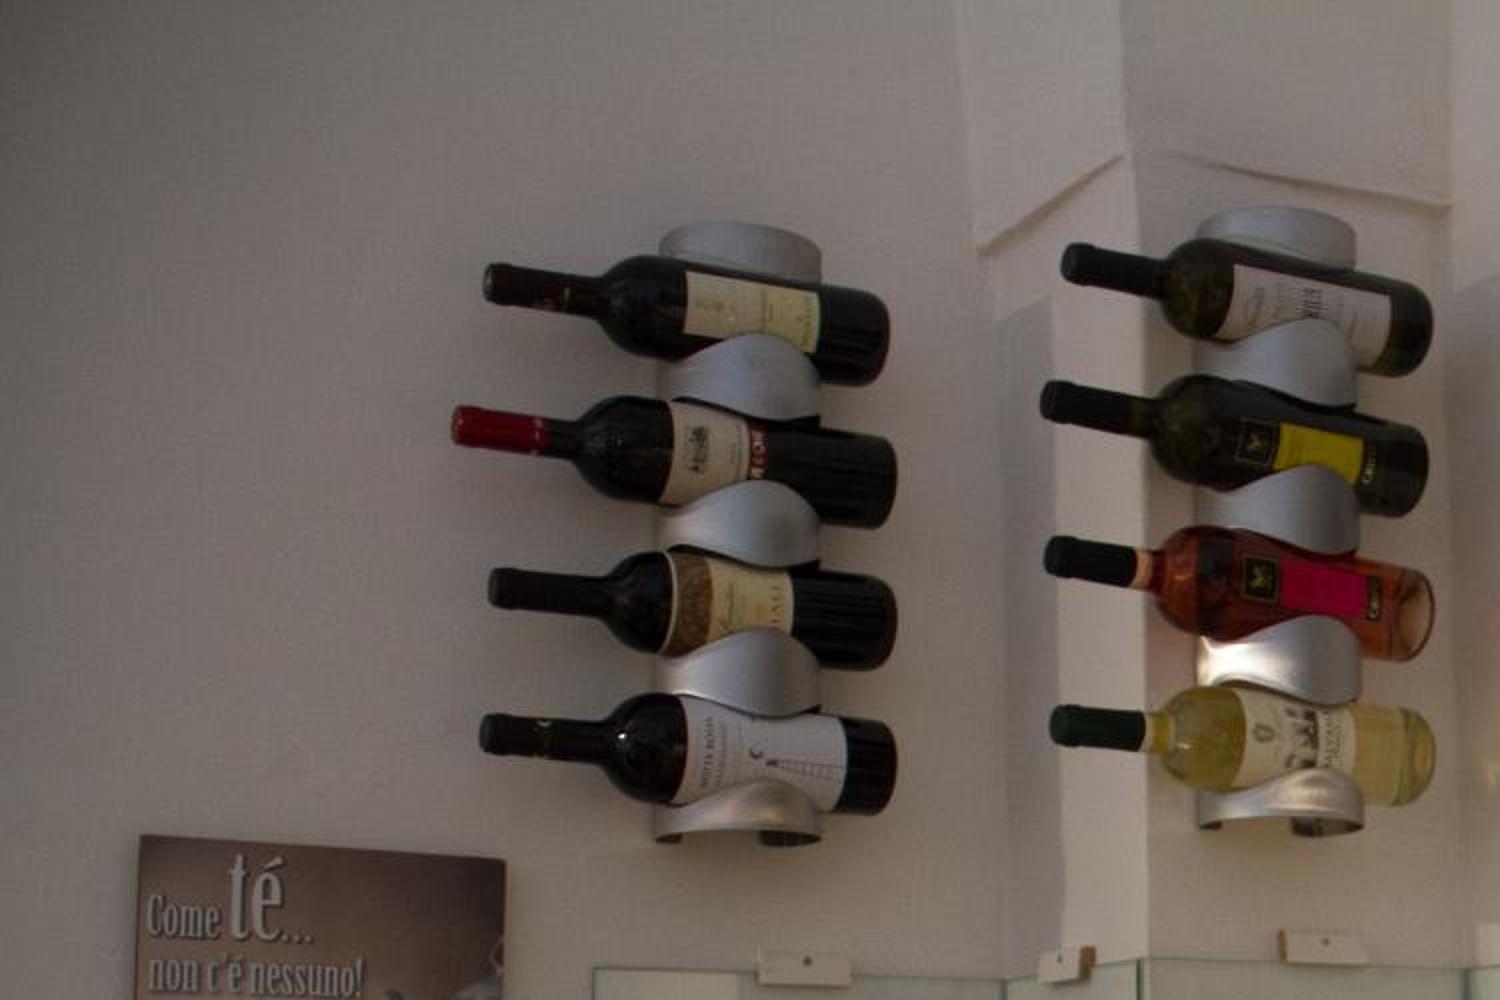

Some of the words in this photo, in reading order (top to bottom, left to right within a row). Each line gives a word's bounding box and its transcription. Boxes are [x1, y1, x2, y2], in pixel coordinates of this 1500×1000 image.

[148, 893, 221, 938] Come
[149, 958, 198, 993] non
[251, 955, 363, 998] nessuno!
